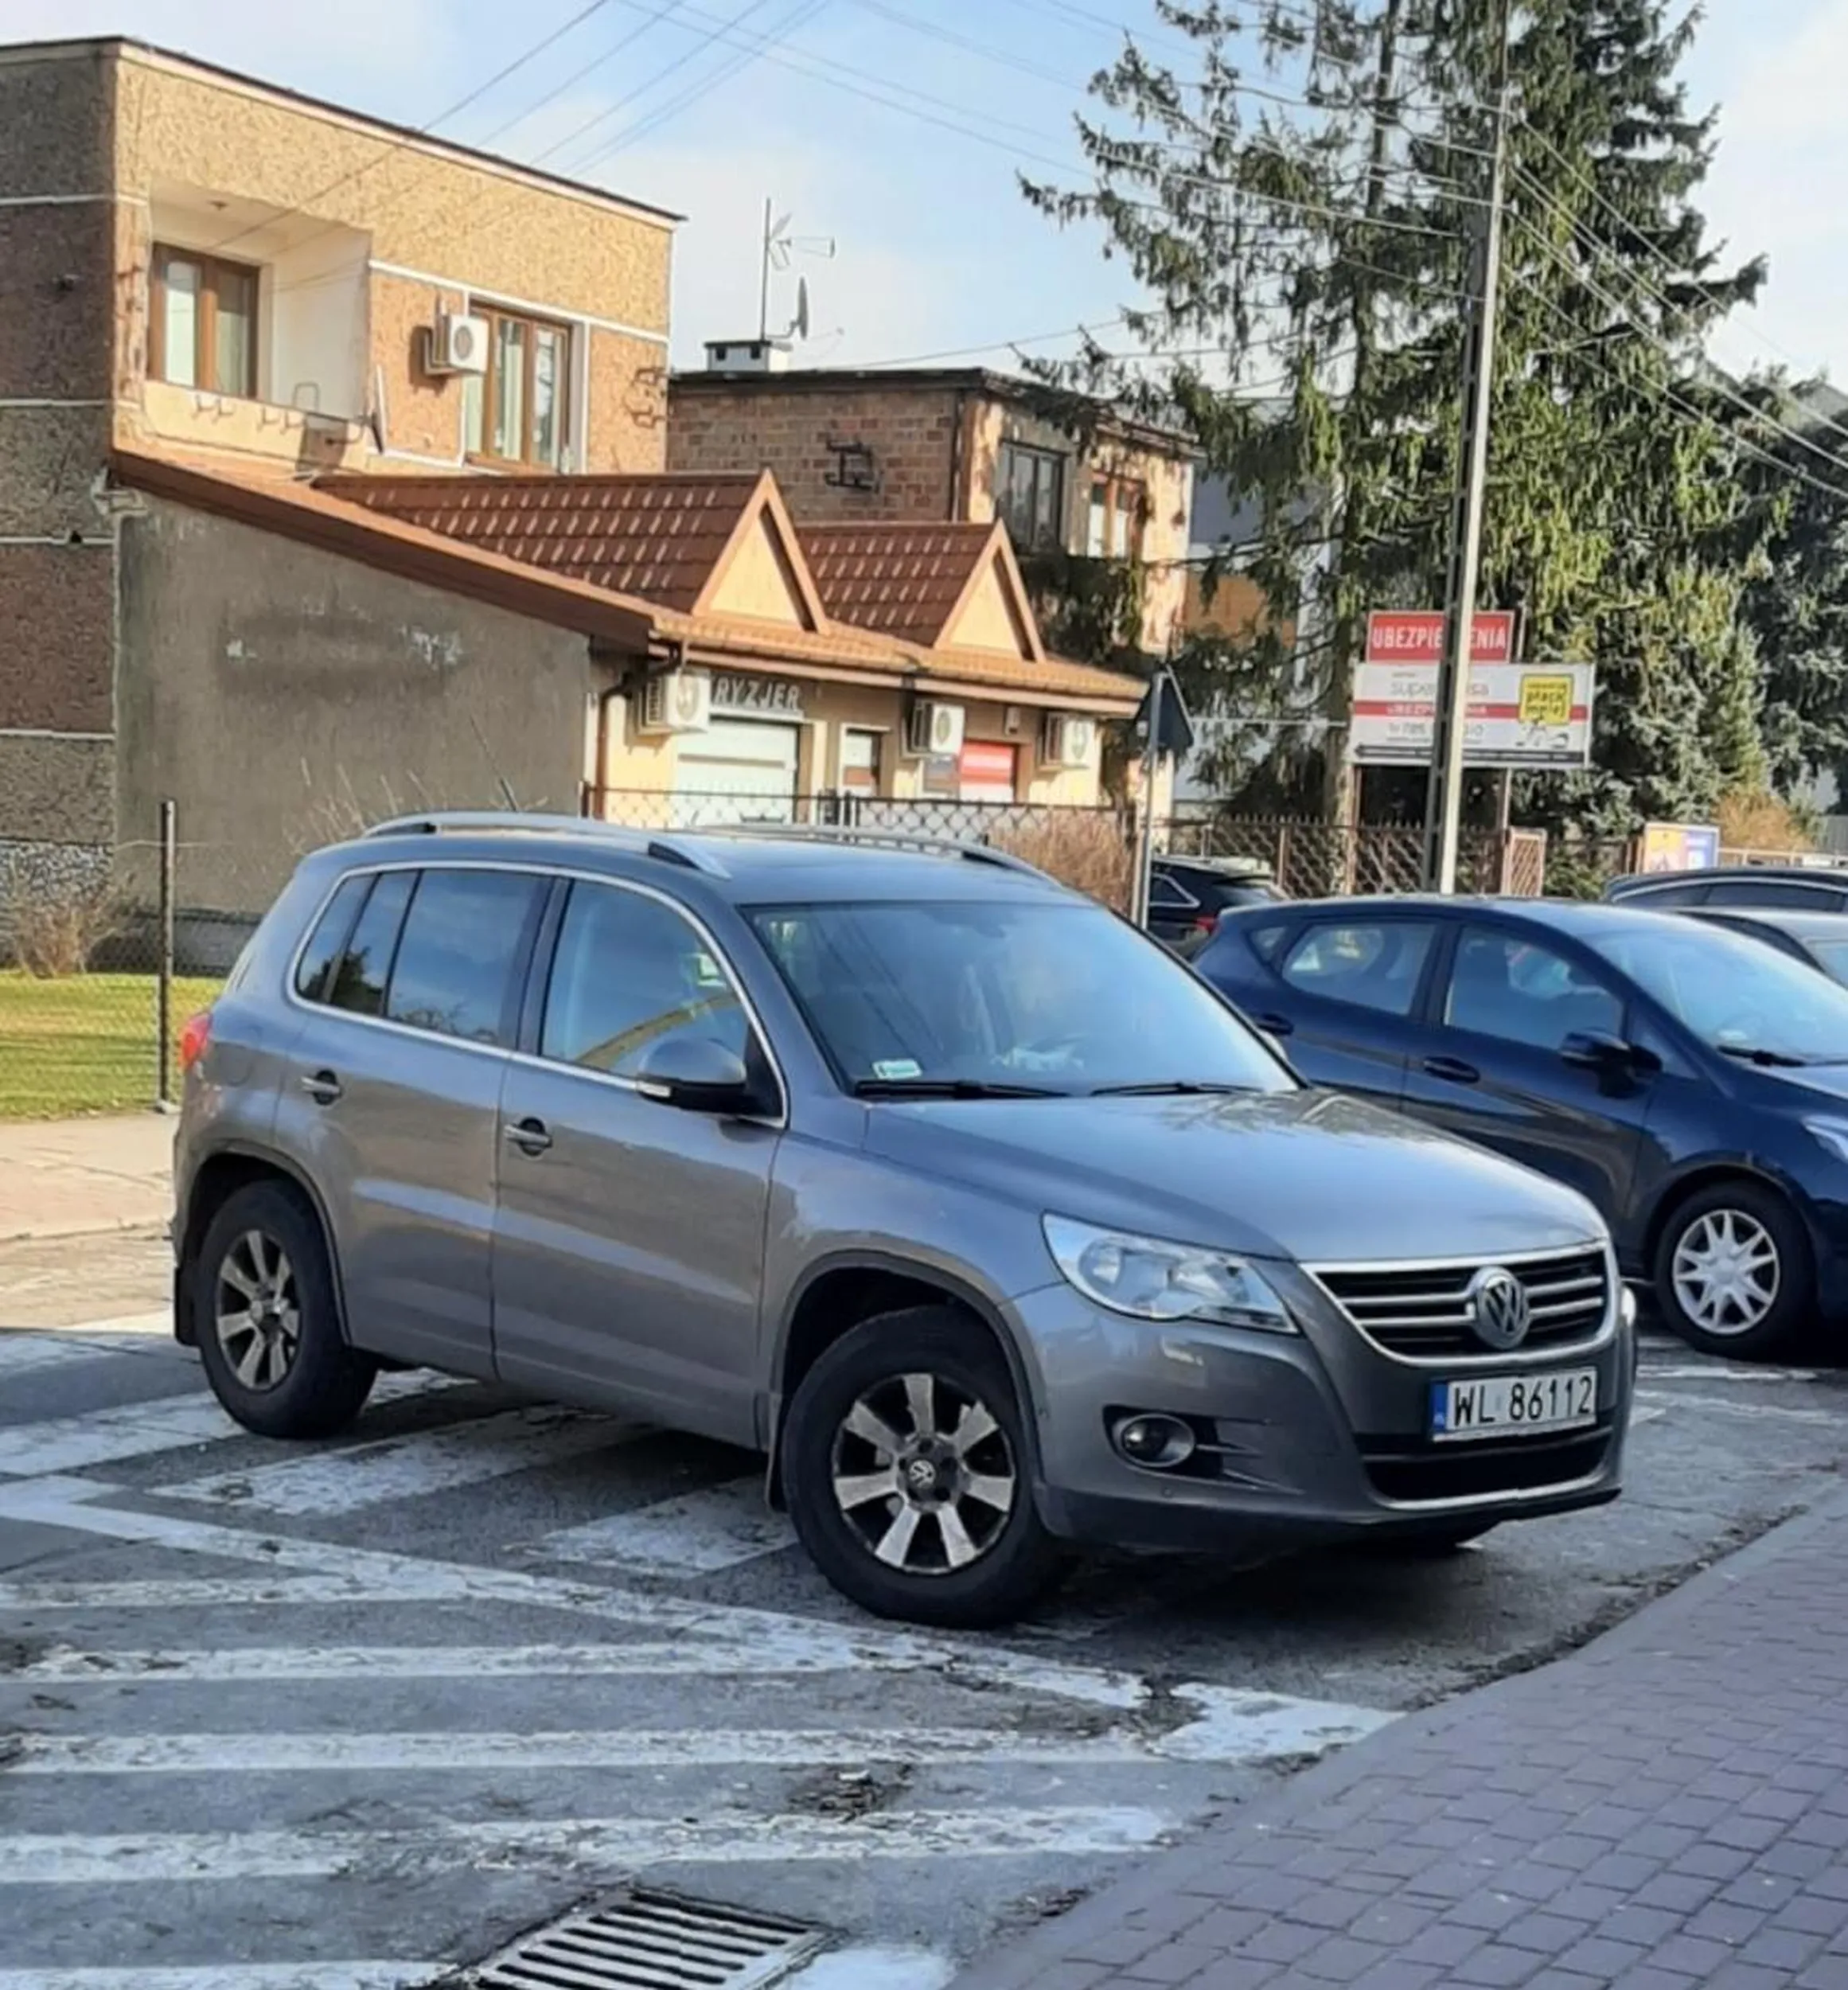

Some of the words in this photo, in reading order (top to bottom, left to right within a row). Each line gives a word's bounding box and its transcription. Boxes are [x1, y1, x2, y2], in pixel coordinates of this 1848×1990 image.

[1372, 626, 1506, 650] UBEZPIEENIA
[714, 677, 800, 711] RYZJER
[1454, 1383, 1495, 1426] WL
[1509, 1375, 1593, 1422] 86112
